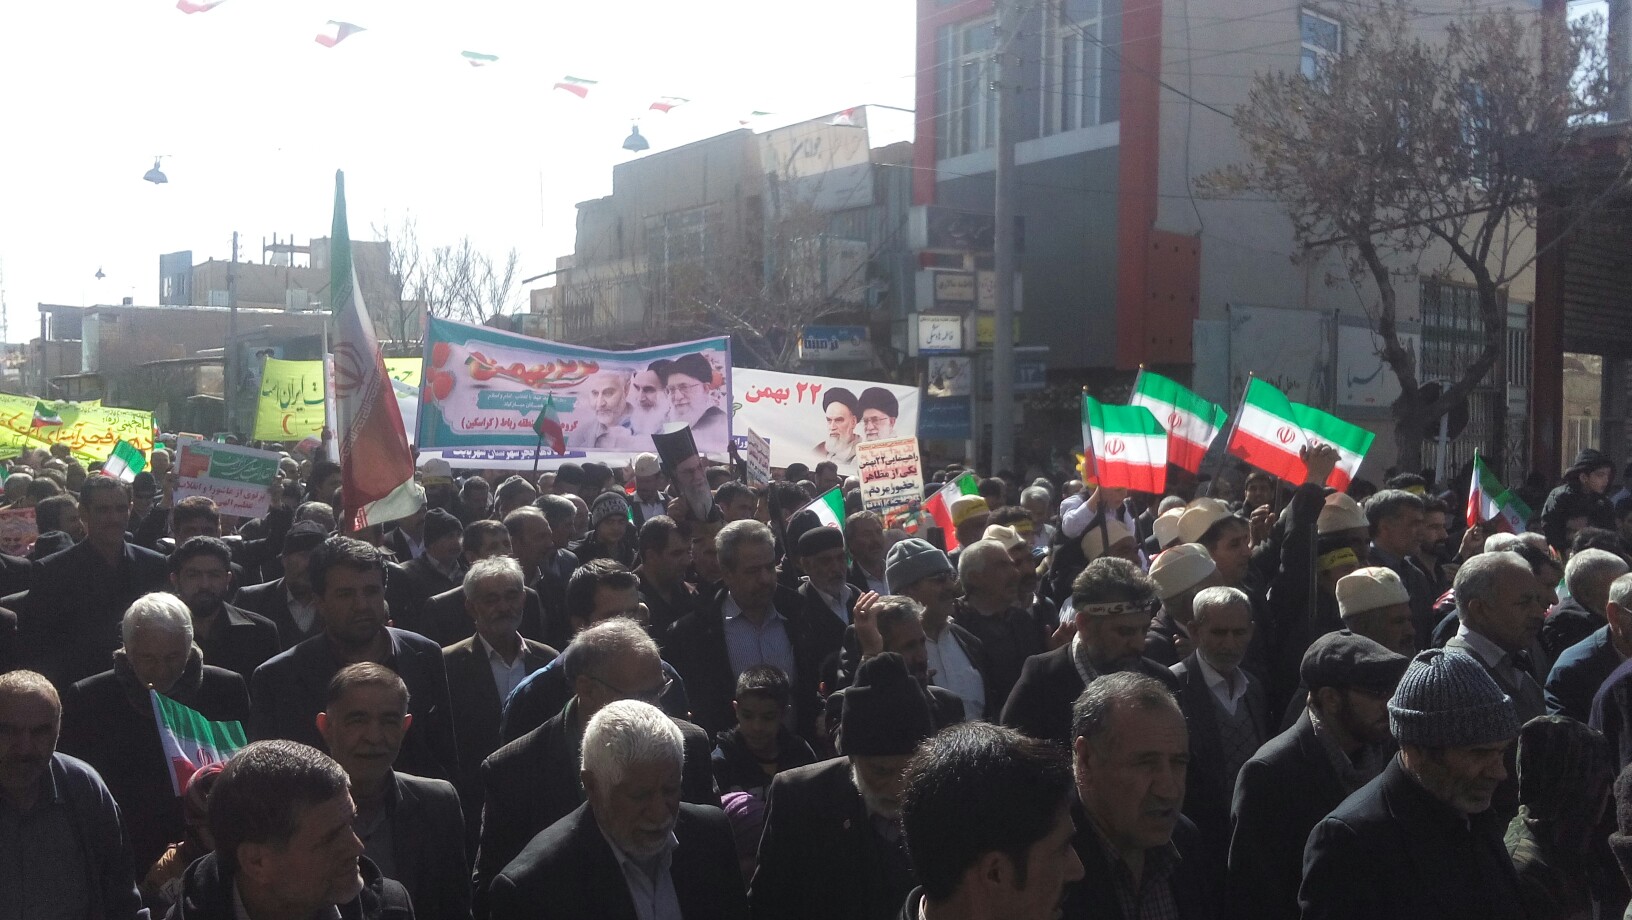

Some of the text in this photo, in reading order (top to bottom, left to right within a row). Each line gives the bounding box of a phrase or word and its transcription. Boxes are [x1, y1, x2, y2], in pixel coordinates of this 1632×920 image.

[745, 382, 822, 406] ۲۲ بهمن
[117, 419, 138, 432] خمینی
[500, 417, 516, 429] رباط
[518, 418, 534, 428] نطقه
[70, 427, 113, 450] فجر
[864, 465, 918, 484] یکی از مظاهر
[209, 484, 234, 495] عاشورا
[869, 481, 915, 497] حضور مردم
